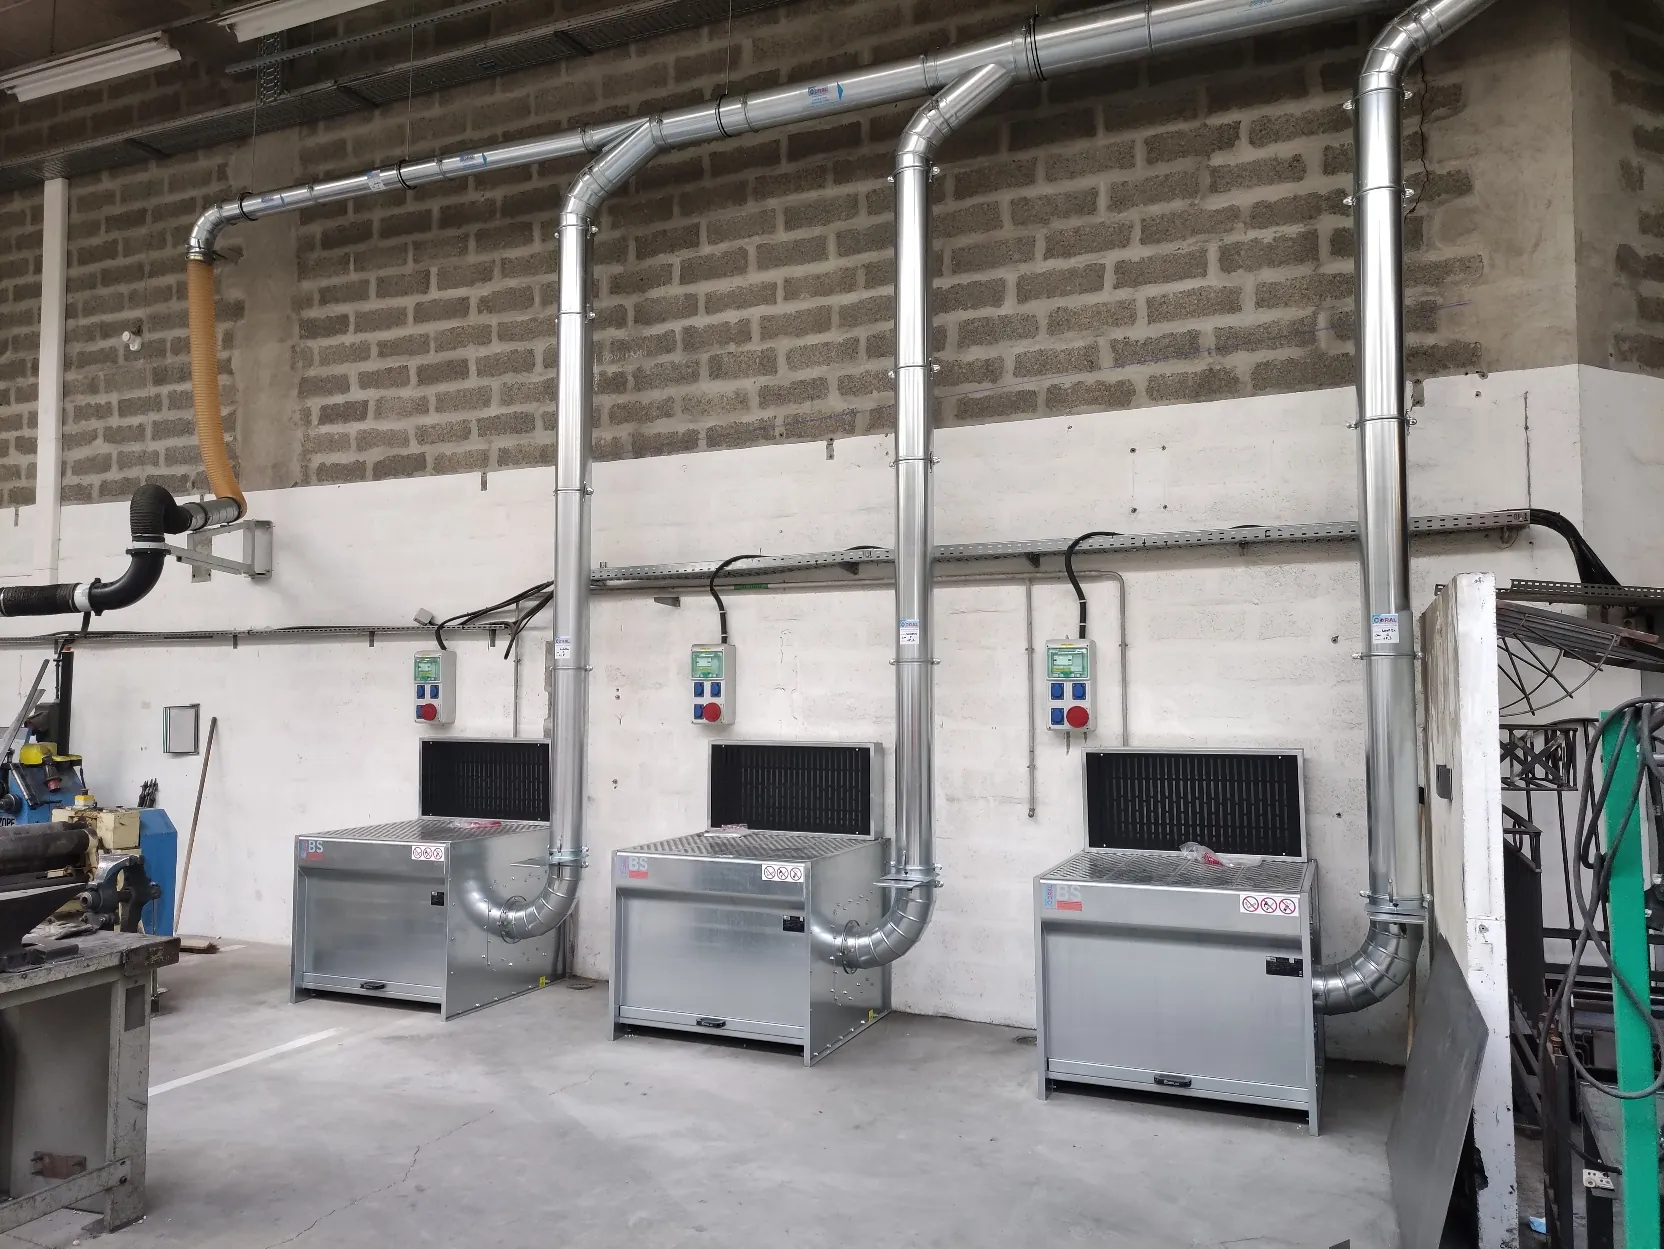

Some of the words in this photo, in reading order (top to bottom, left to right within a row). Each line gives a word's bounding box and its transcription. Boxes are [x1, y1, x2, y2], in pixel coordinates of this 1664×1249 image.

[308, 840, 324, 853] BS
[629, 856, 648, 871] BS
[1056, 884, 1082, 901] BS
